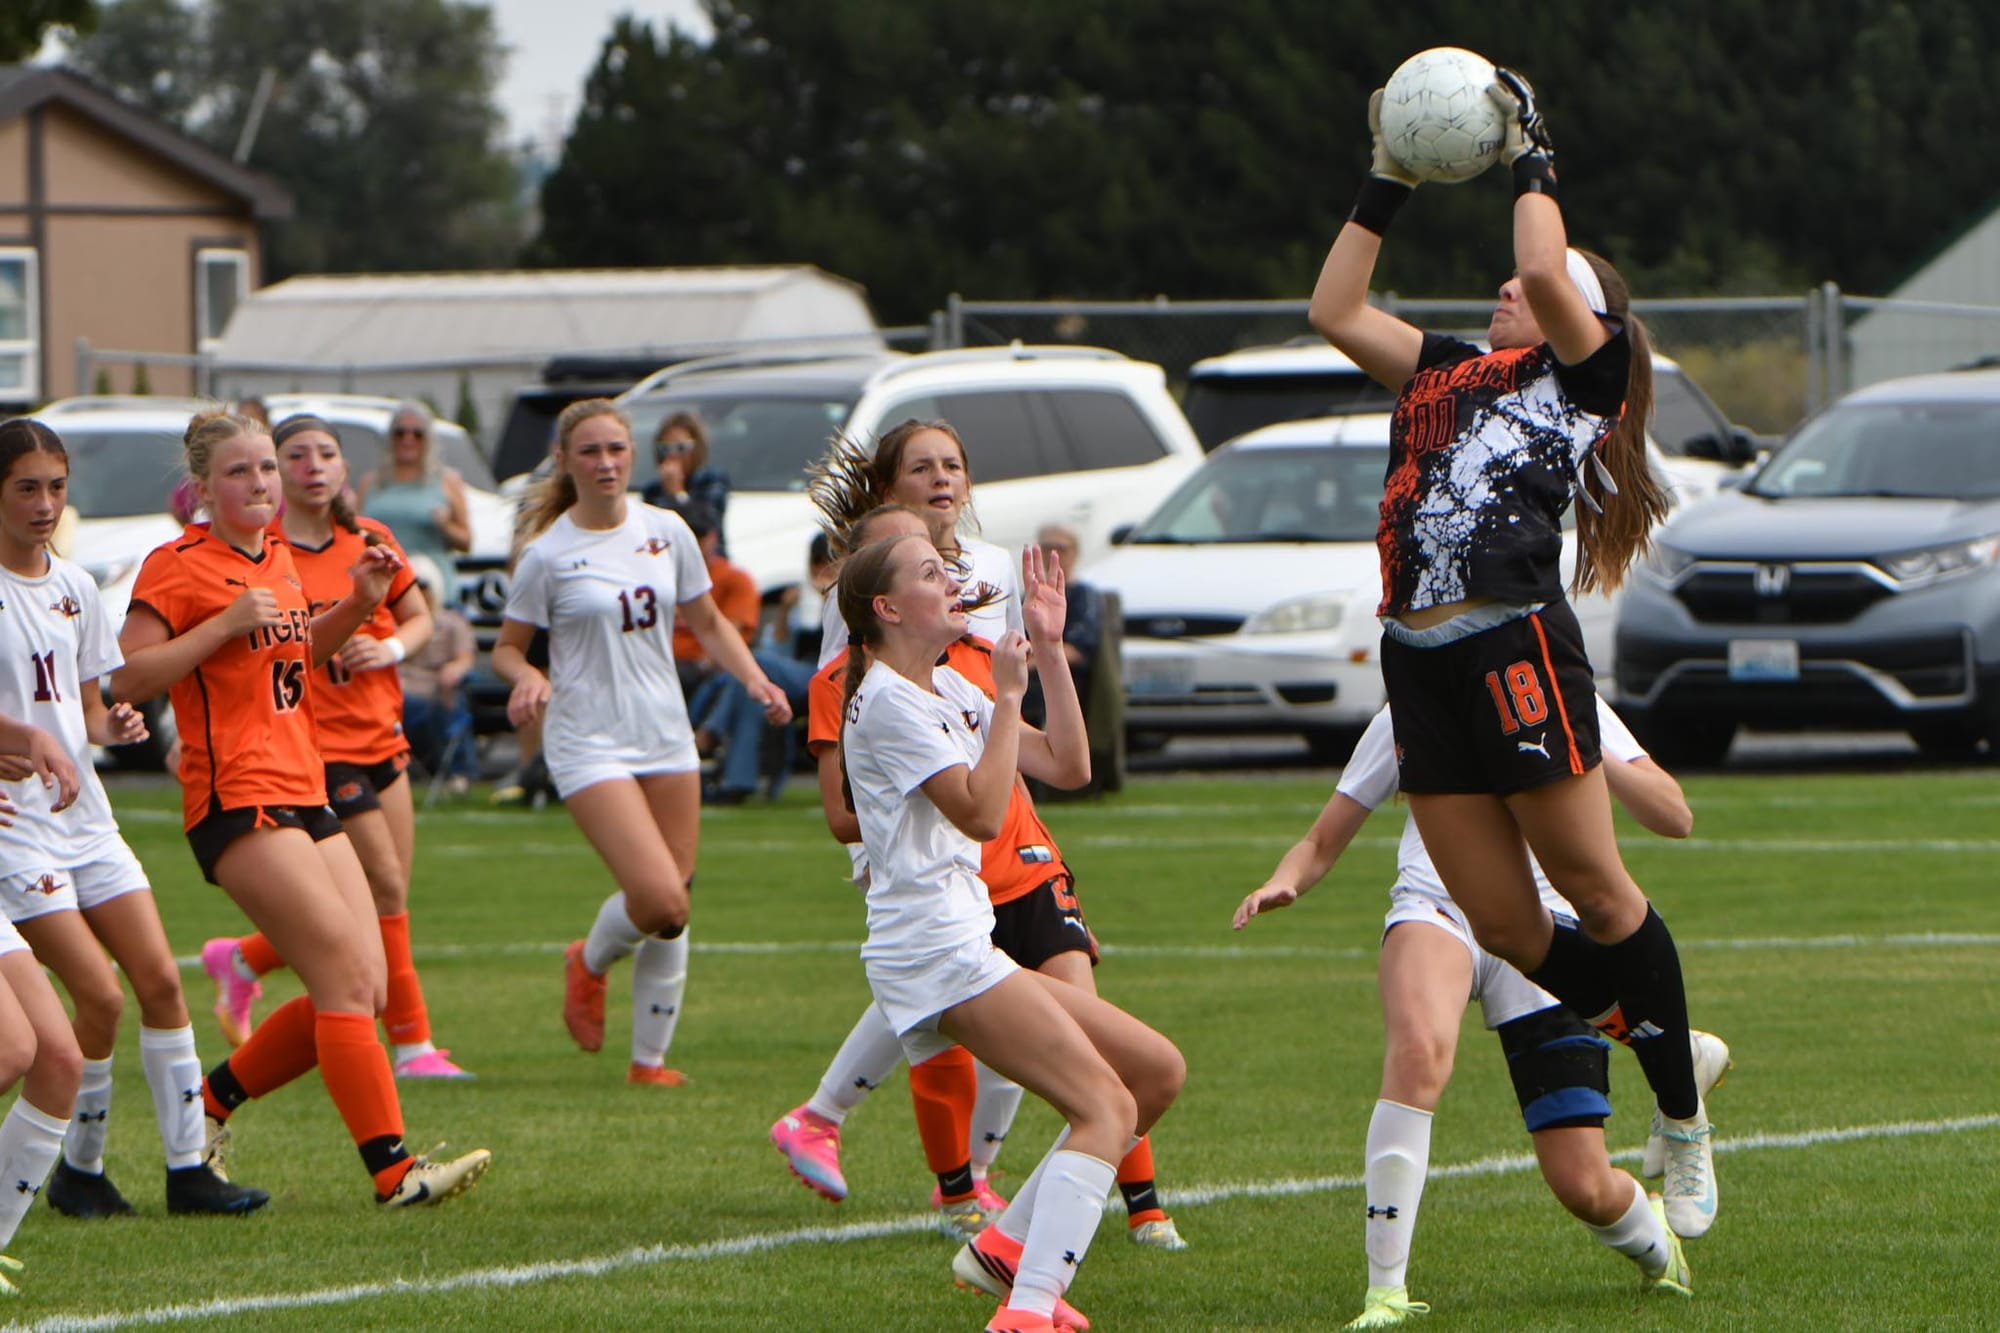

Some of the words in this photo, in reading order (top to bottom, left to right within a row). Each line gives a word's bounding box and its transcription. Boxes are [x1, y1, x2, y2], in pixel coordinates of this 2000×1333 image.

[618, 586, 657, 632] 13
[271, 659, 306, 714] 15
[1485, 660, 1548, 735] 18
